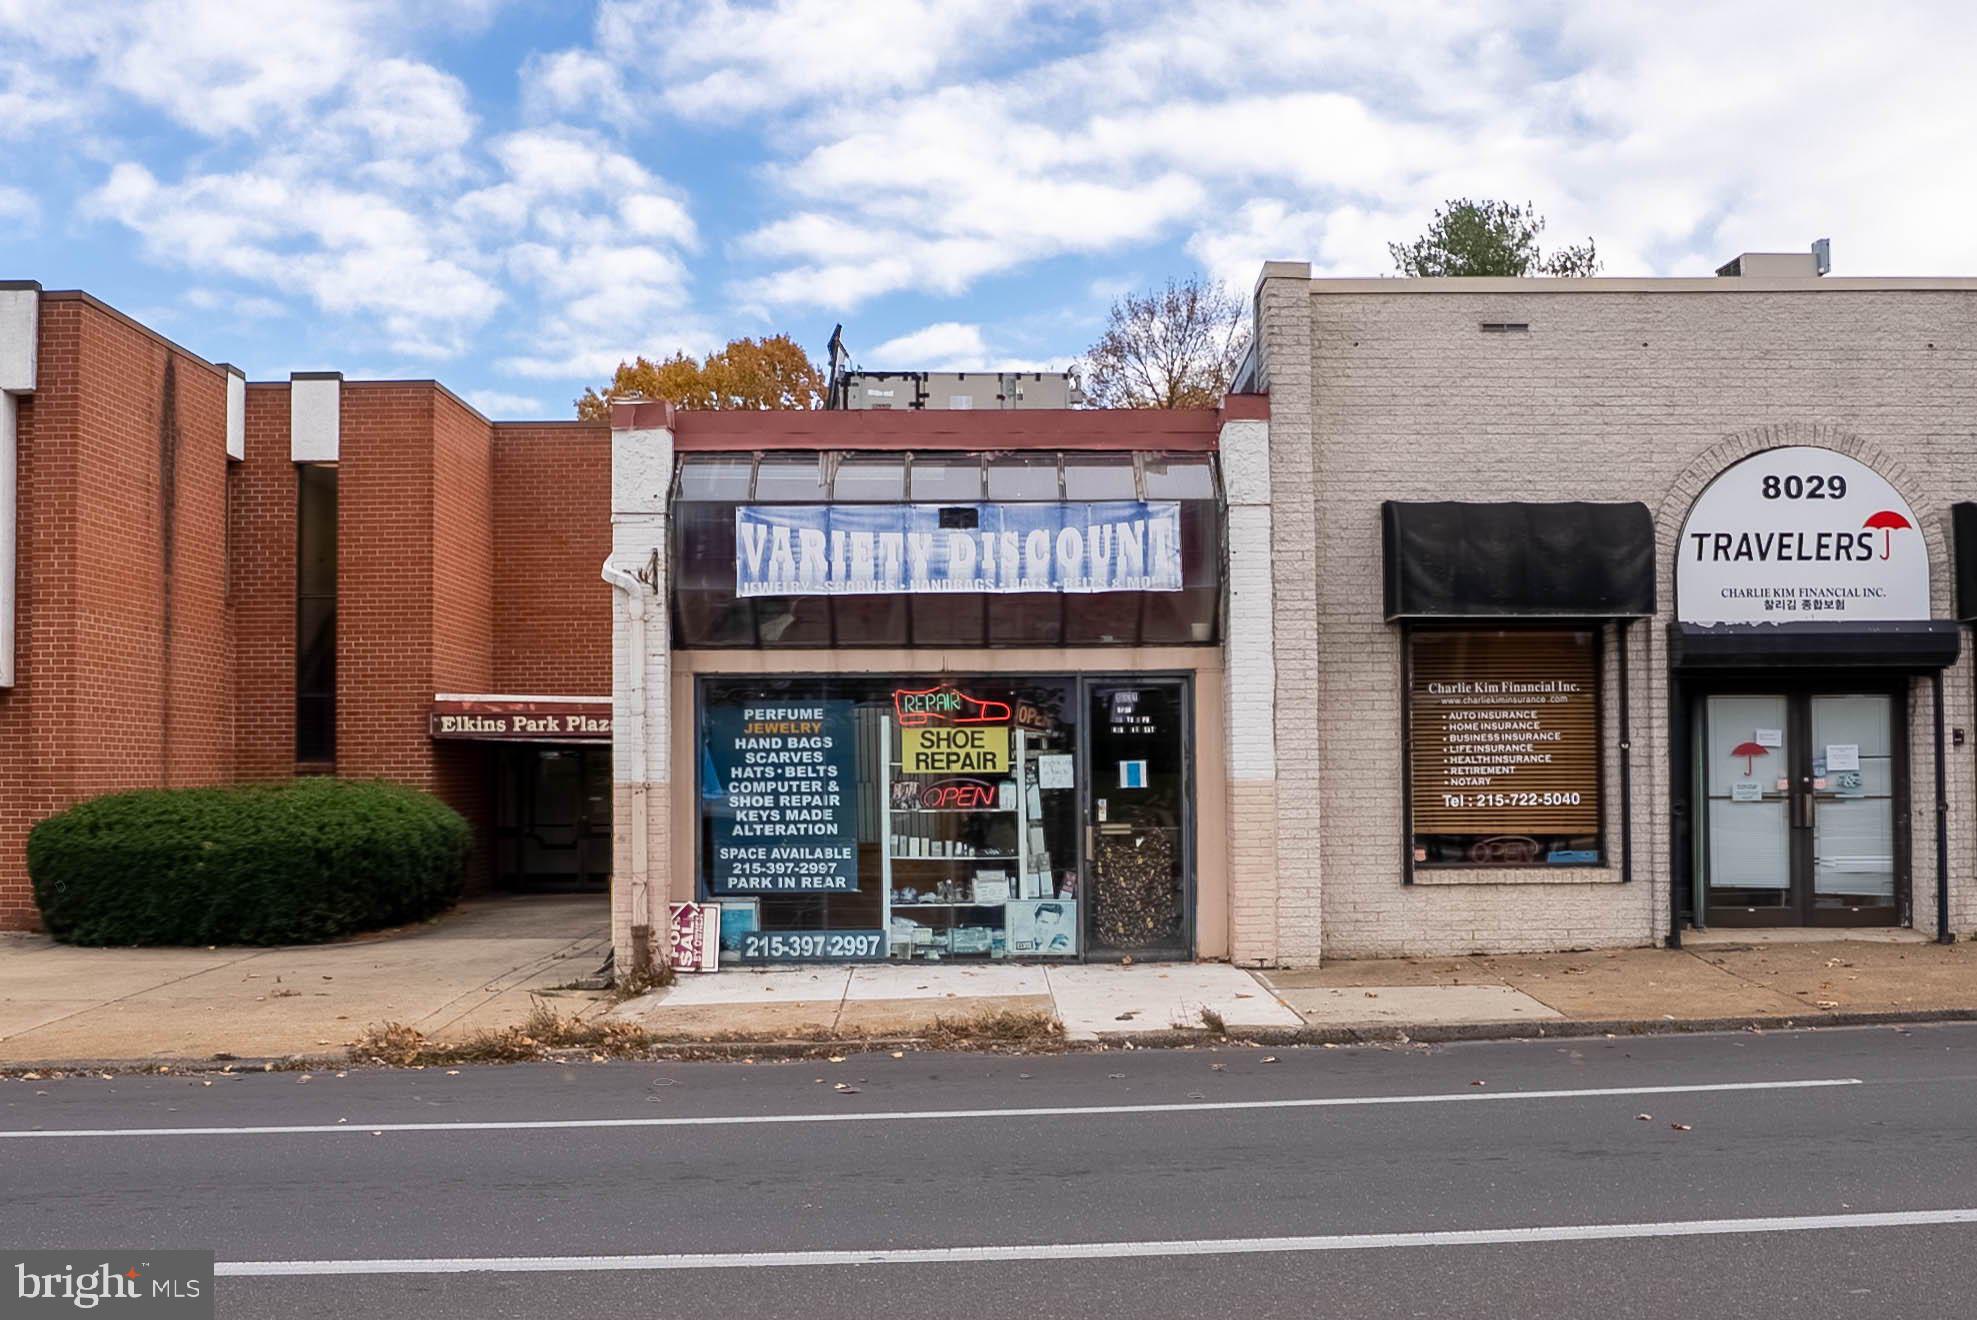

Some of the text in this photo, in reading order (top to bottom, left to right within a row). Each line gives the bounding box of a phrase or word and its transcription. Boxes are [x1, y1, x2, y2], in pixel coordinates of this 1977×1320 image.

[1762, 475, 1847, 499] 8029
[740, 518, 1173, 579] VARIETY DISCOUNT
[1691, 532, 1873, 562] TRAVELERS
[743, 581, 809, 594] JEWELRY
[910, 578, 995, 591] HANDBAGS
[1721, 587, 1886, 598] CHARLIE KIM FINANCIAL INC.
[1428, 681, 1580, 694] Charlie Kim Financial Inc.
[904, 694, 961, 713] REPAIR
[743, 708, 824, 721] PERFUME
[1477, 711, 1537, 719] INSURANCE
[441, 716, 612, 732] Elkins Park Plaz
[743, 722, 822, 734] JEWELRY
[1450, 722, 1540, 731] HOME INSURANCE
[735, 737, 833, 750] HAND BAGS
[920, 730, 985, 749] SHOE
[1450, 732, 1560, 742] BUSINESS INSURANCE
[1474, 744, 1533, 752] INSURANCE
[745, 752, 824, 764] SCARVES
[915, 752, 997, 770] REPAIR
[1450, 754, 1551, 764] HEALTH INSURANCE
[731, 766, 838, 779] HATS BELTS
[1450, 766, 1515, 775] RETIREMENT
[728, 780, 840, 794] COMPUTER &
[1450, 777, 1491, 786] NOTARY
[728, 795, 841, 808] SHOE REPAIR
[924, 786, 995, 806] OPEN
[1443, 795, 1464, 807] Tel
[1477, 793, 1580, 807] 215-722-5040
[736, 809, 833, 822] KEYS MADE
[732, 824, 838, 837] ALTERATION
[720, 848, 851, 860] SPACE AVAILABLE
[733, 863, 837, 874] 215-397-2997
[728, 877, 847, 889] PARK IN REAR
[745, 935, 880, 956] 215-397-2997
